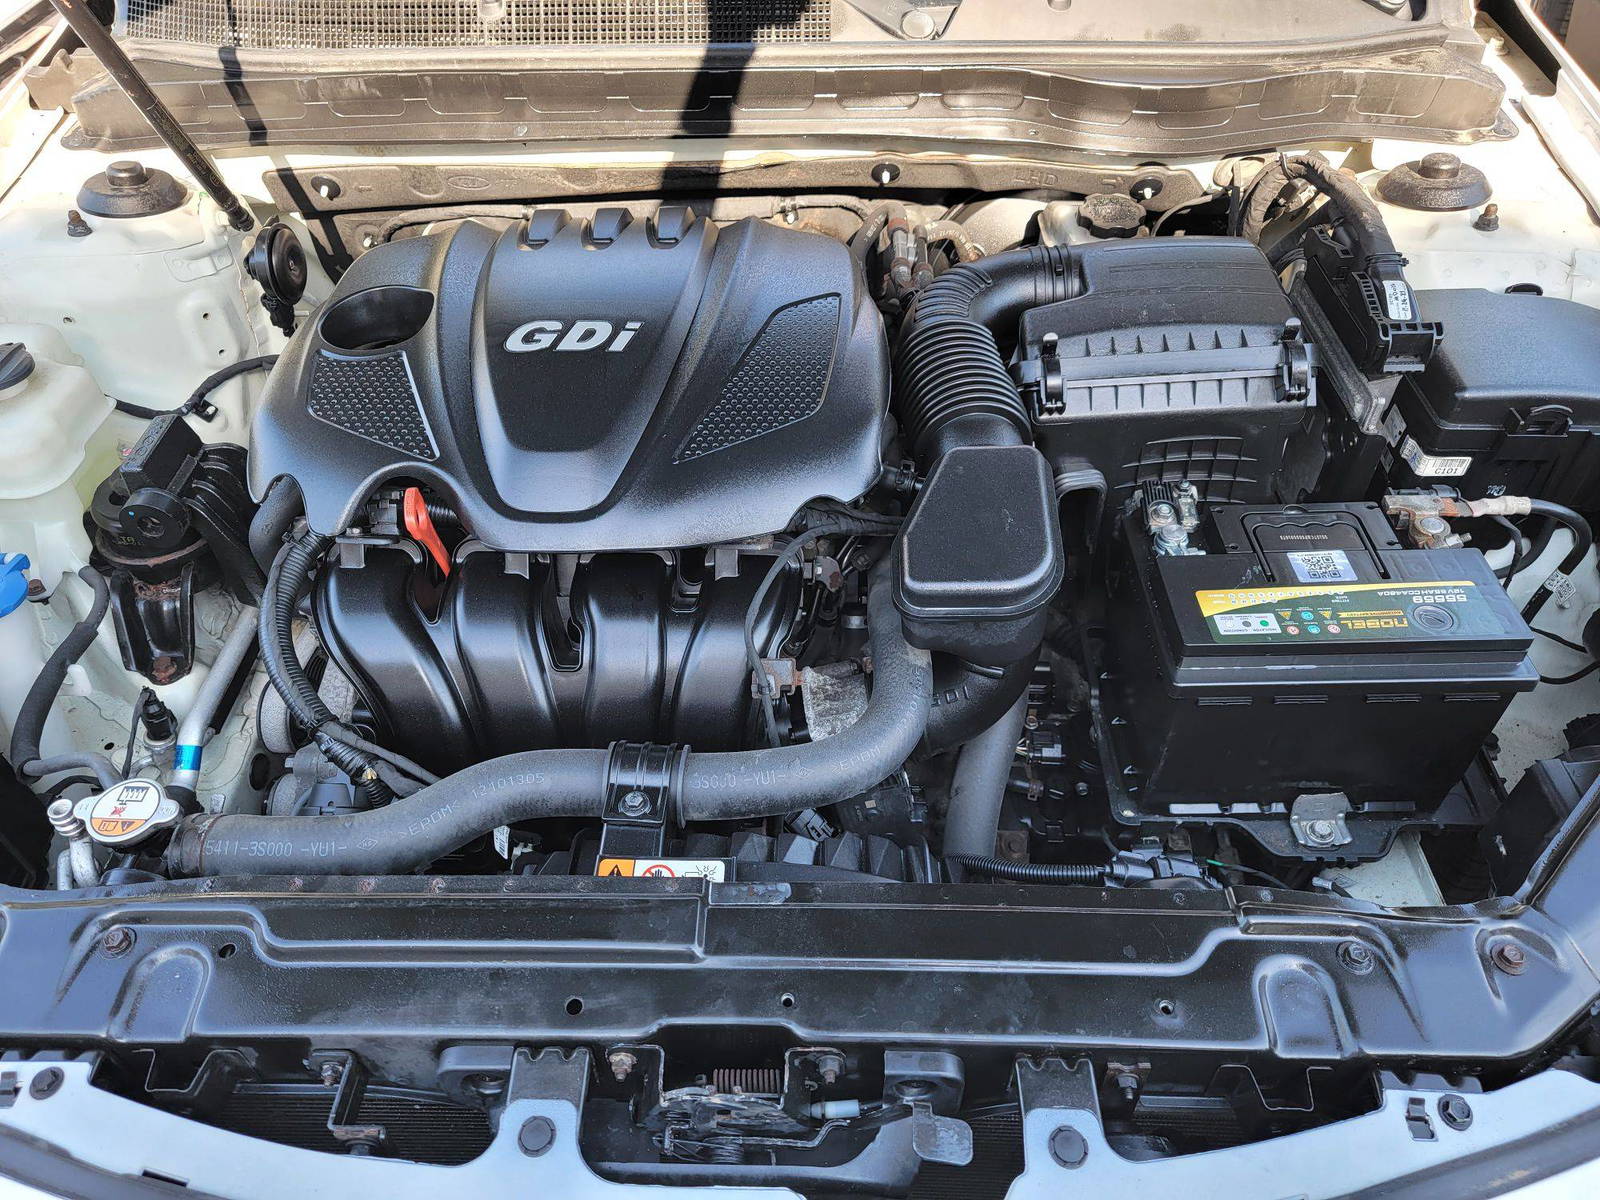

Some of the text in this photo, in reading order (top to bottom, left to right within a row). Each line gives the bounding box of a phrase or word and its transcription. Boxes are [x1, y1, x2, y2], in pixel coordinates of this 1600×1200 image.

[503, 320, 645, 352] GDi
[1412, 594, 1467, 604] 55559
[1341, 617, 1409, 630] NOBEL
[203, 840, 293, 857] 5411-3S000
